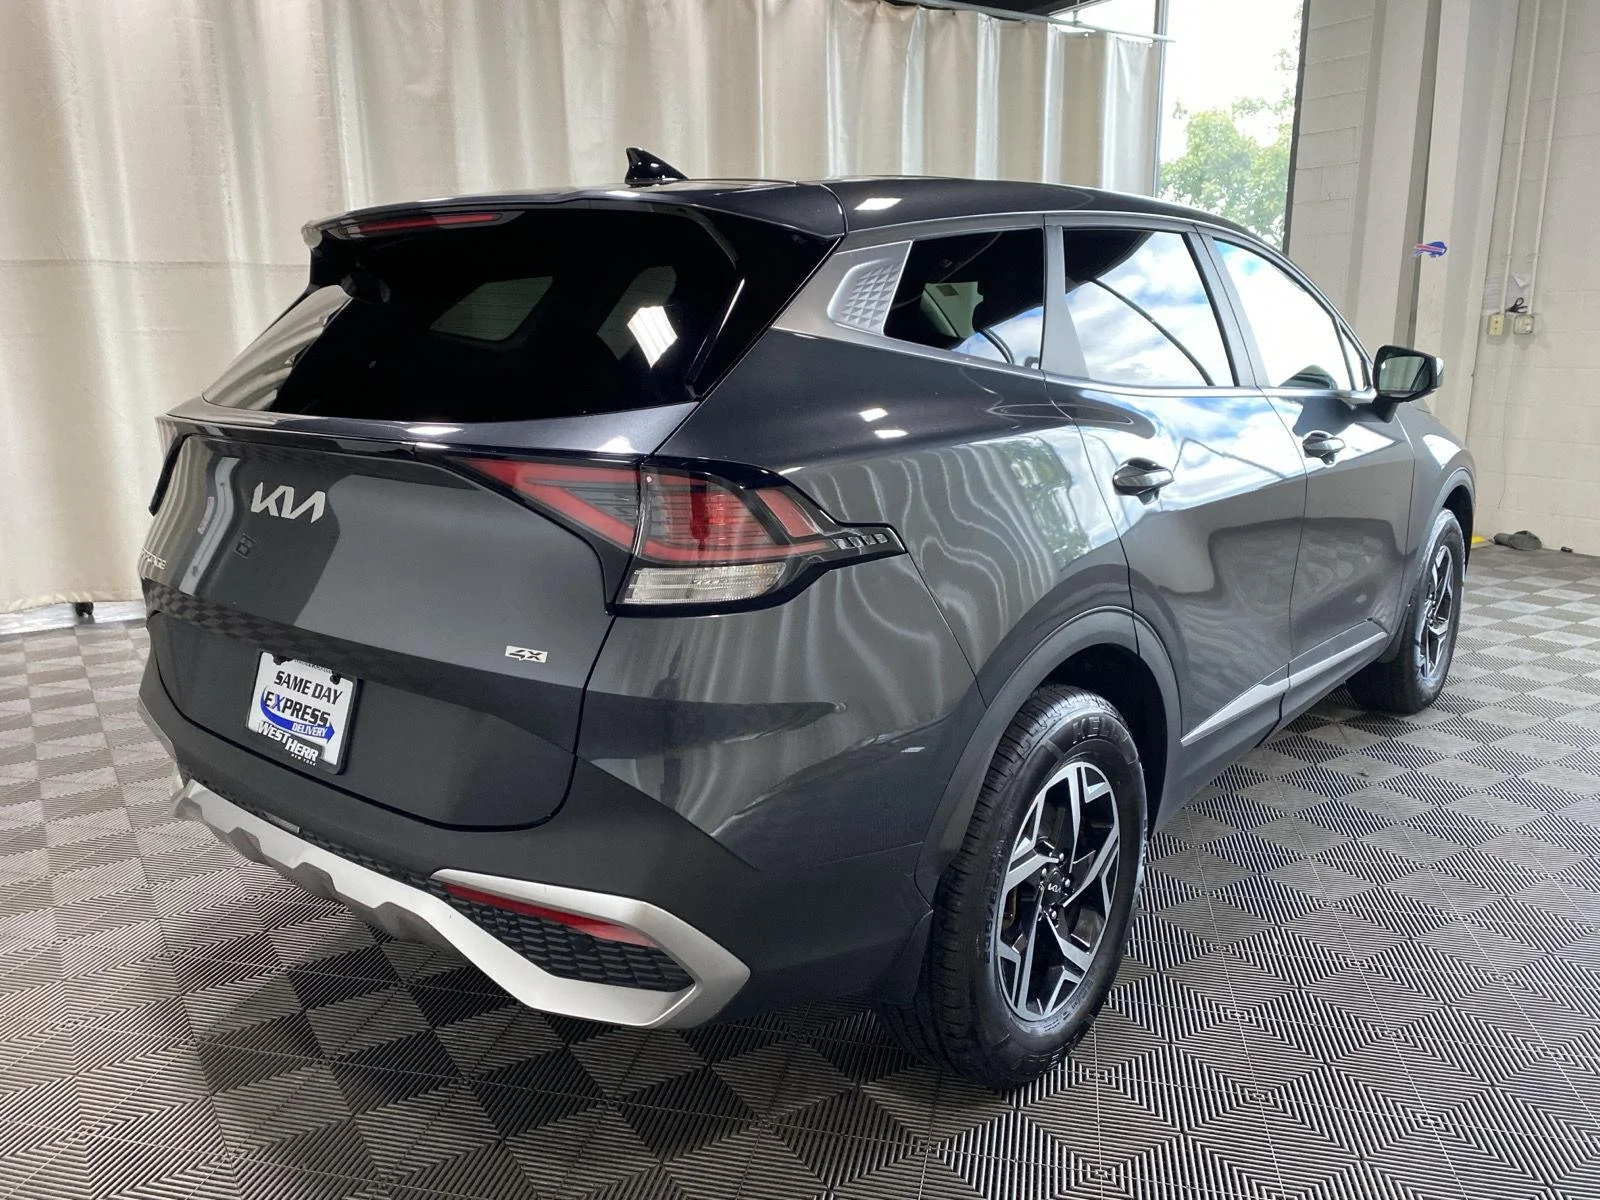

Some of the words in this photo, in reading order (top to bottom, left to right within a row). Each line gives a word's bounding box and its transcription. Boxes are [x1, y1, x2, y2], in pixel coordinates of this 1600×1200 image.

[251, 482, 326, 523] KIA
[274, 670, 312, 695] SAME
[311, 683, 343, 705] DAY
[264, 690, 330, 728] EXPRESS
[292, 722, 328, 738] DELIVERY
